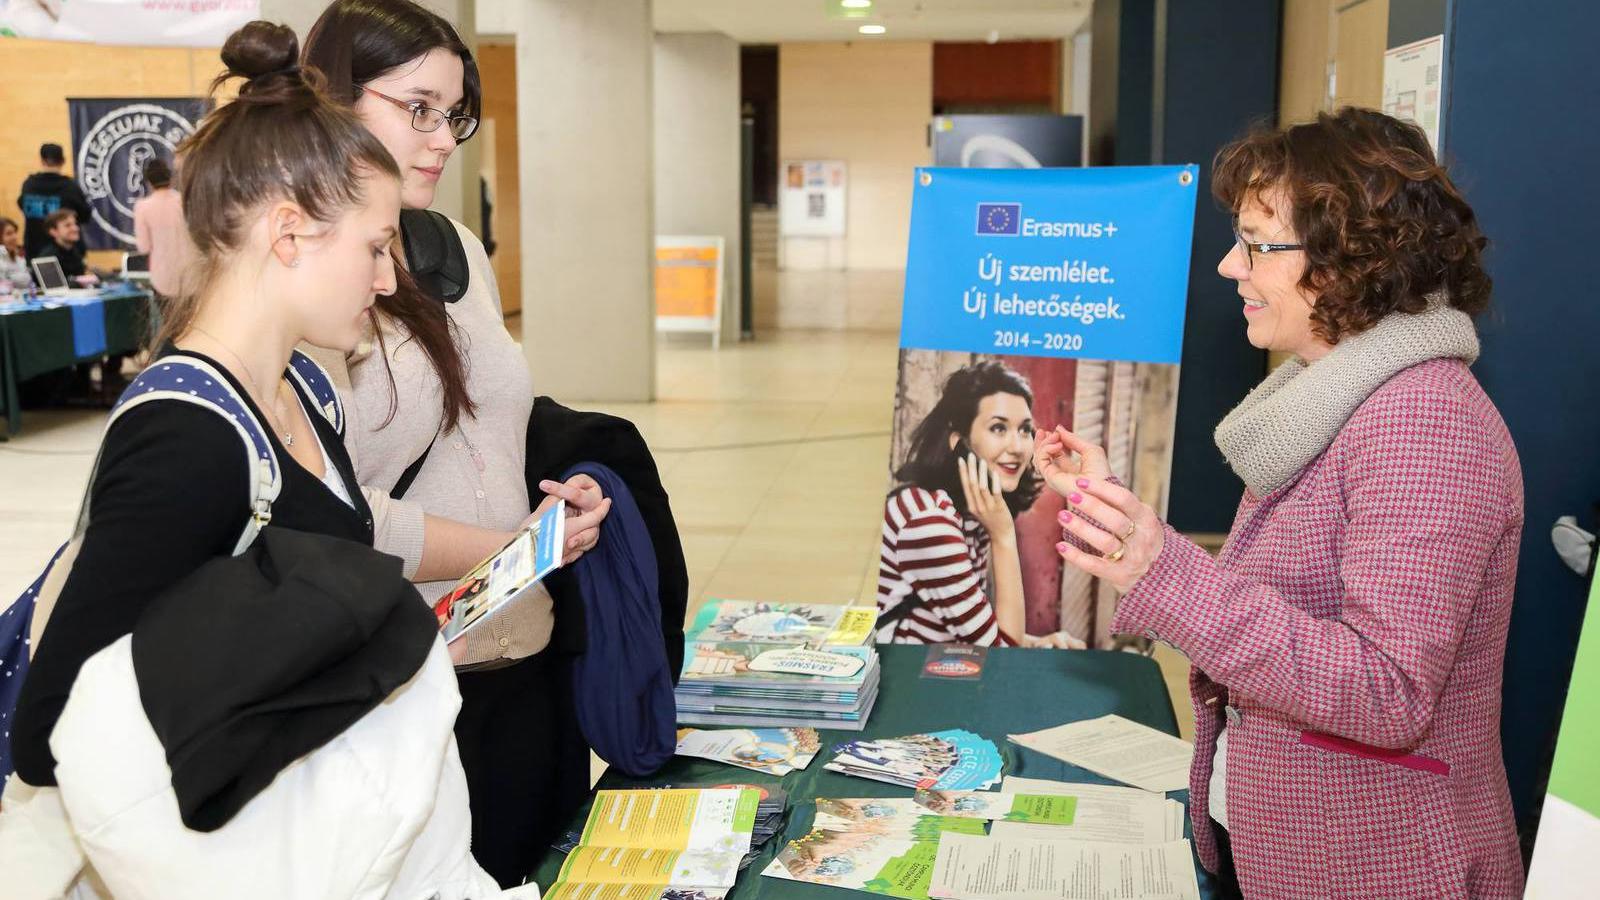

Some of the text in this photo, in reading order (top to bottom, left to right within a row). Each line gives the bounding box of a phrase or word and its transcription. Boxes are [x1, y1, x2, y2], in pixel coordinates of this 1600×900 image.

[1022, 218, 1118, 238] Erasmus+
[978, 252, 1115, 286] Új szemlélet.
[963, 286, 1126, 325] Új lehetőségek.
